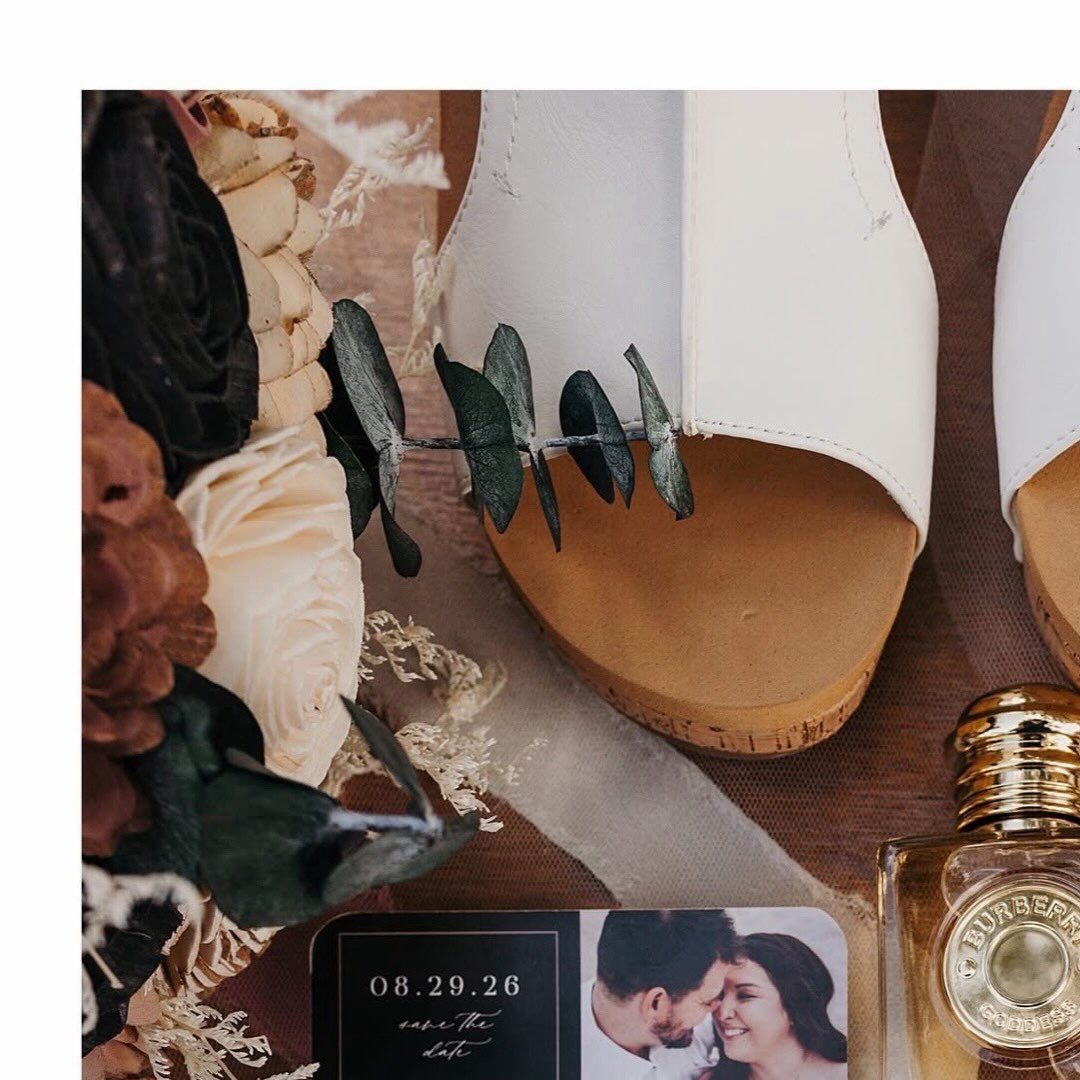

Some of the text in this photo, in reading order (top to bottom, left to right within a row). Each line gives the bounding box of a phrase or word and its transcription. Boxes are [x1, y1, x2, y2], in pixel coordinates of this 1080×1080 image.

[369, 975, 520, 997] 08.29.26
[398, 1009, 502, 1033] save the
[979, 1000, 1077, 1032] GODDESS
[421, 1037, 492, 1060] date
